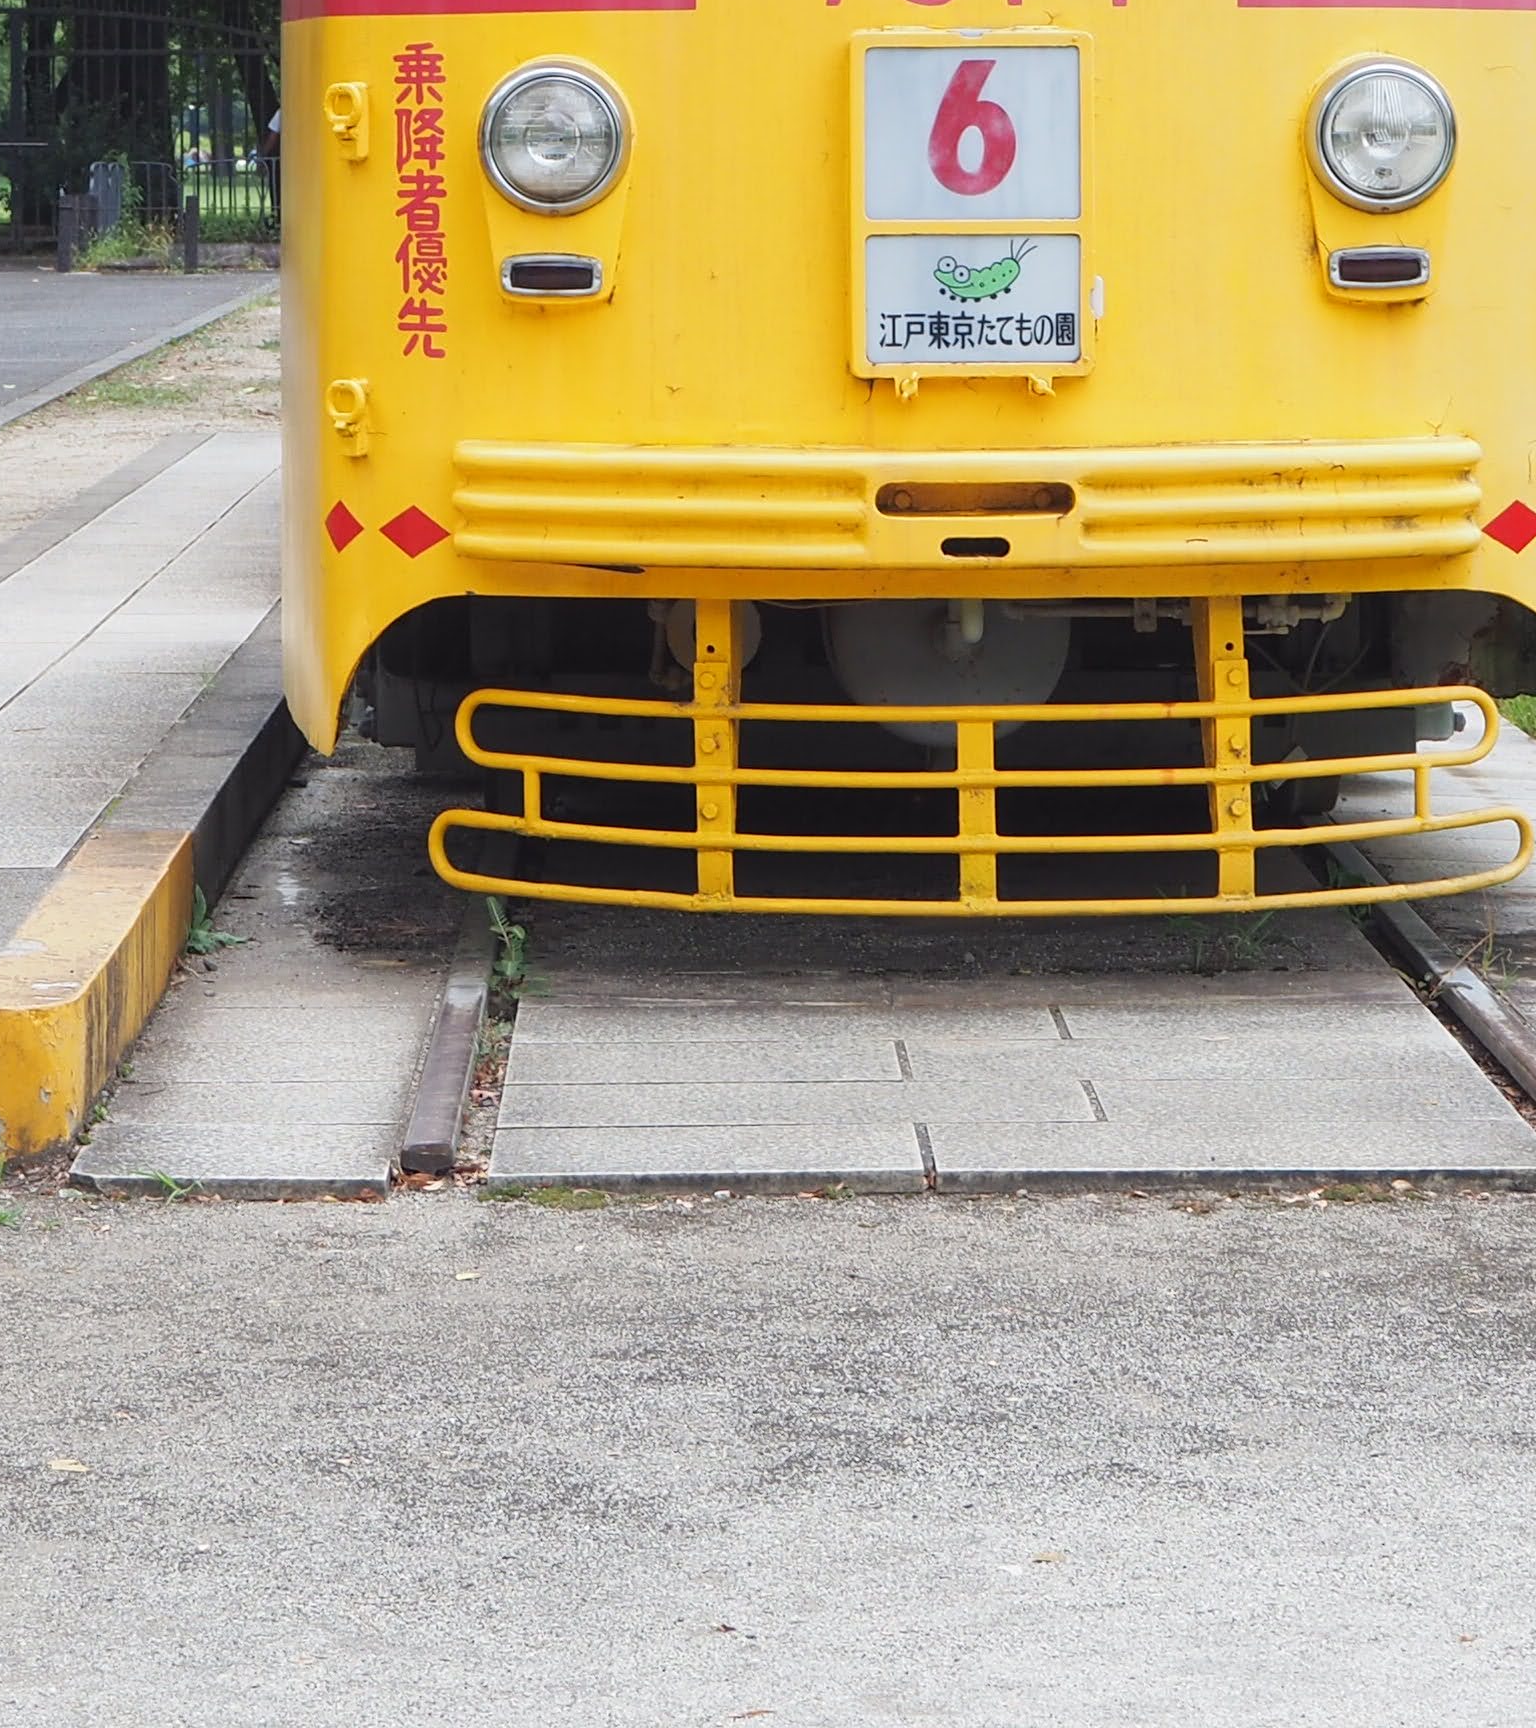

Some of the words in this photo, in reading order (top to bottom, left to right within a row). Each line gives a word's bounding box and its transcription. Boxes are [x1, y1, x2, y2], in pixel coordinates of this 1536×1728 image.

[927, 59, 1018, 196] 6
[392, 41, 449, 359] 乗降者優先
[878, 310, 1076, 351] 江戸東京たてもの園
